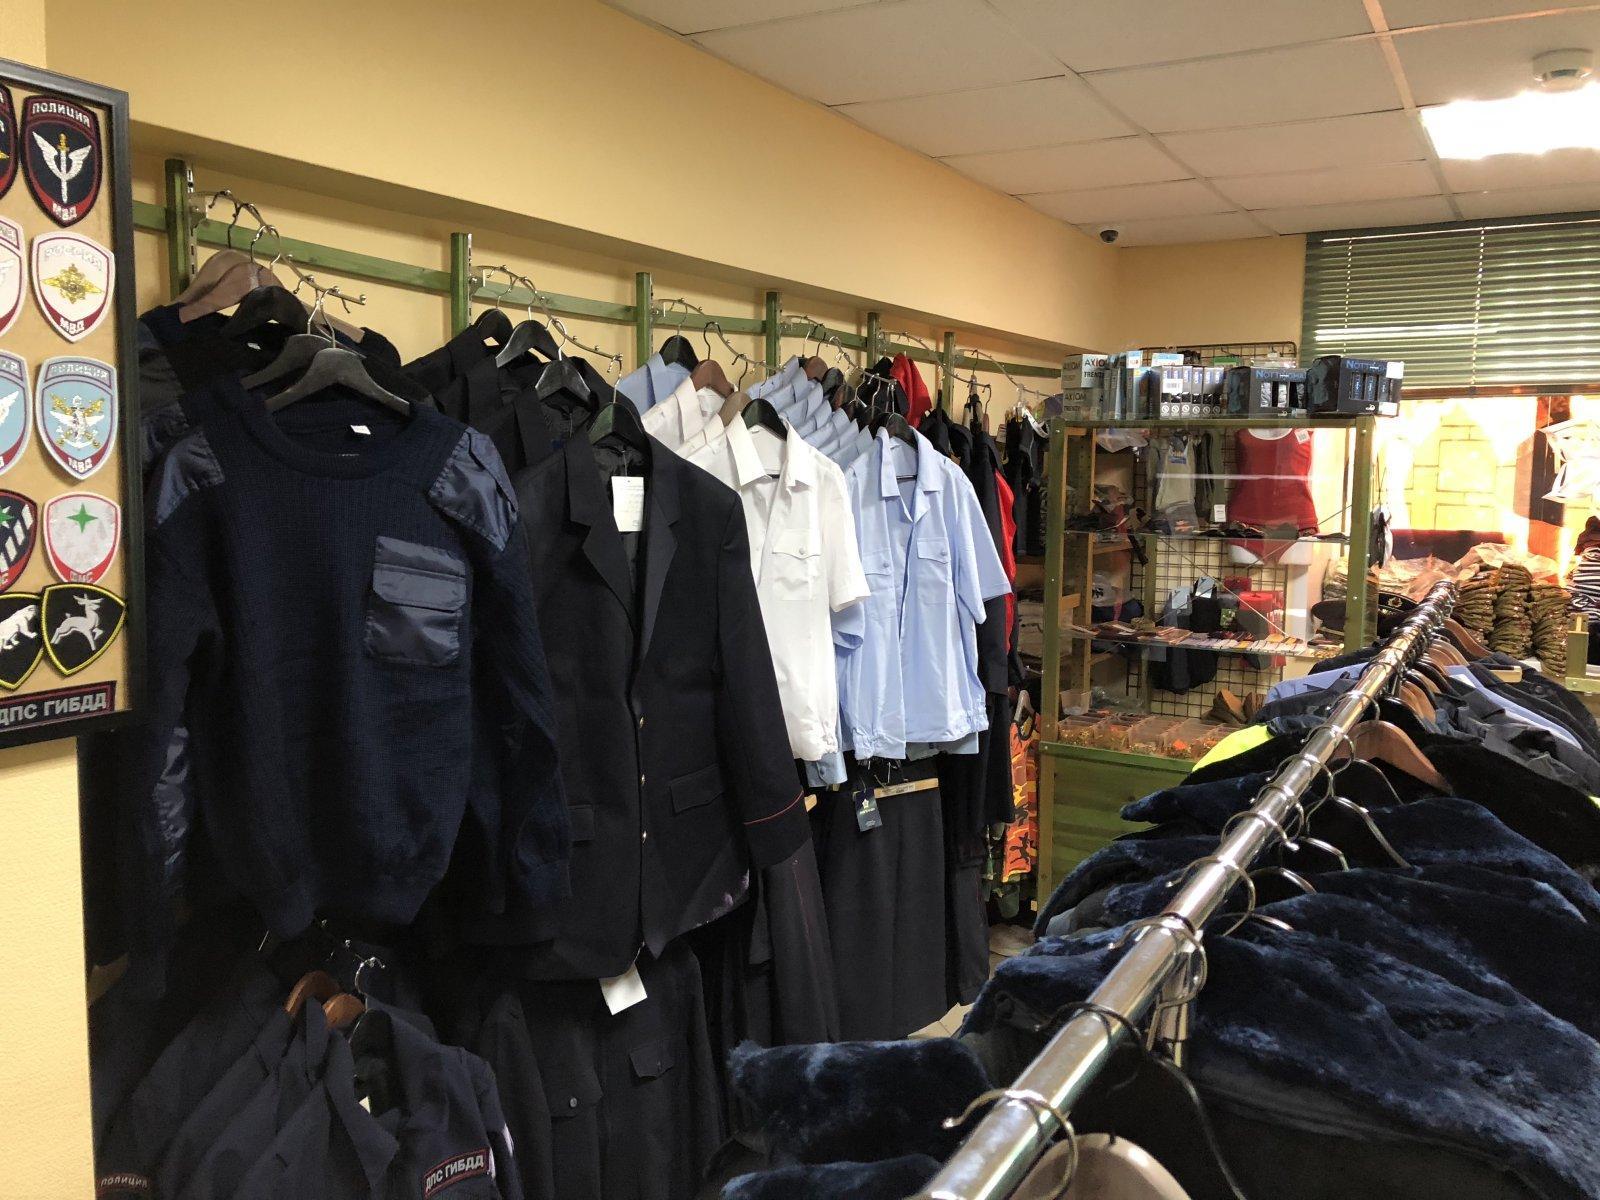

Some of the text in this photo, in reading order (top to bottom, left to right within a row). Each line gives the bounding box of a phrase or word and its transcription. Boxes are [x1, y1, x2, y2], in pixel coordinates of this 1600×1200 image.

[32, 102, 91, 128] ПОЛИЦИЯ
[52, 202, 78, 221] МВД
[0, 692, 107, 726] ДПС ГИБДД
[100, 1175, 148, 1188] ПОЛИЦИЯ
[425, 1155, 484, 1193] ДПС ГИБДД
